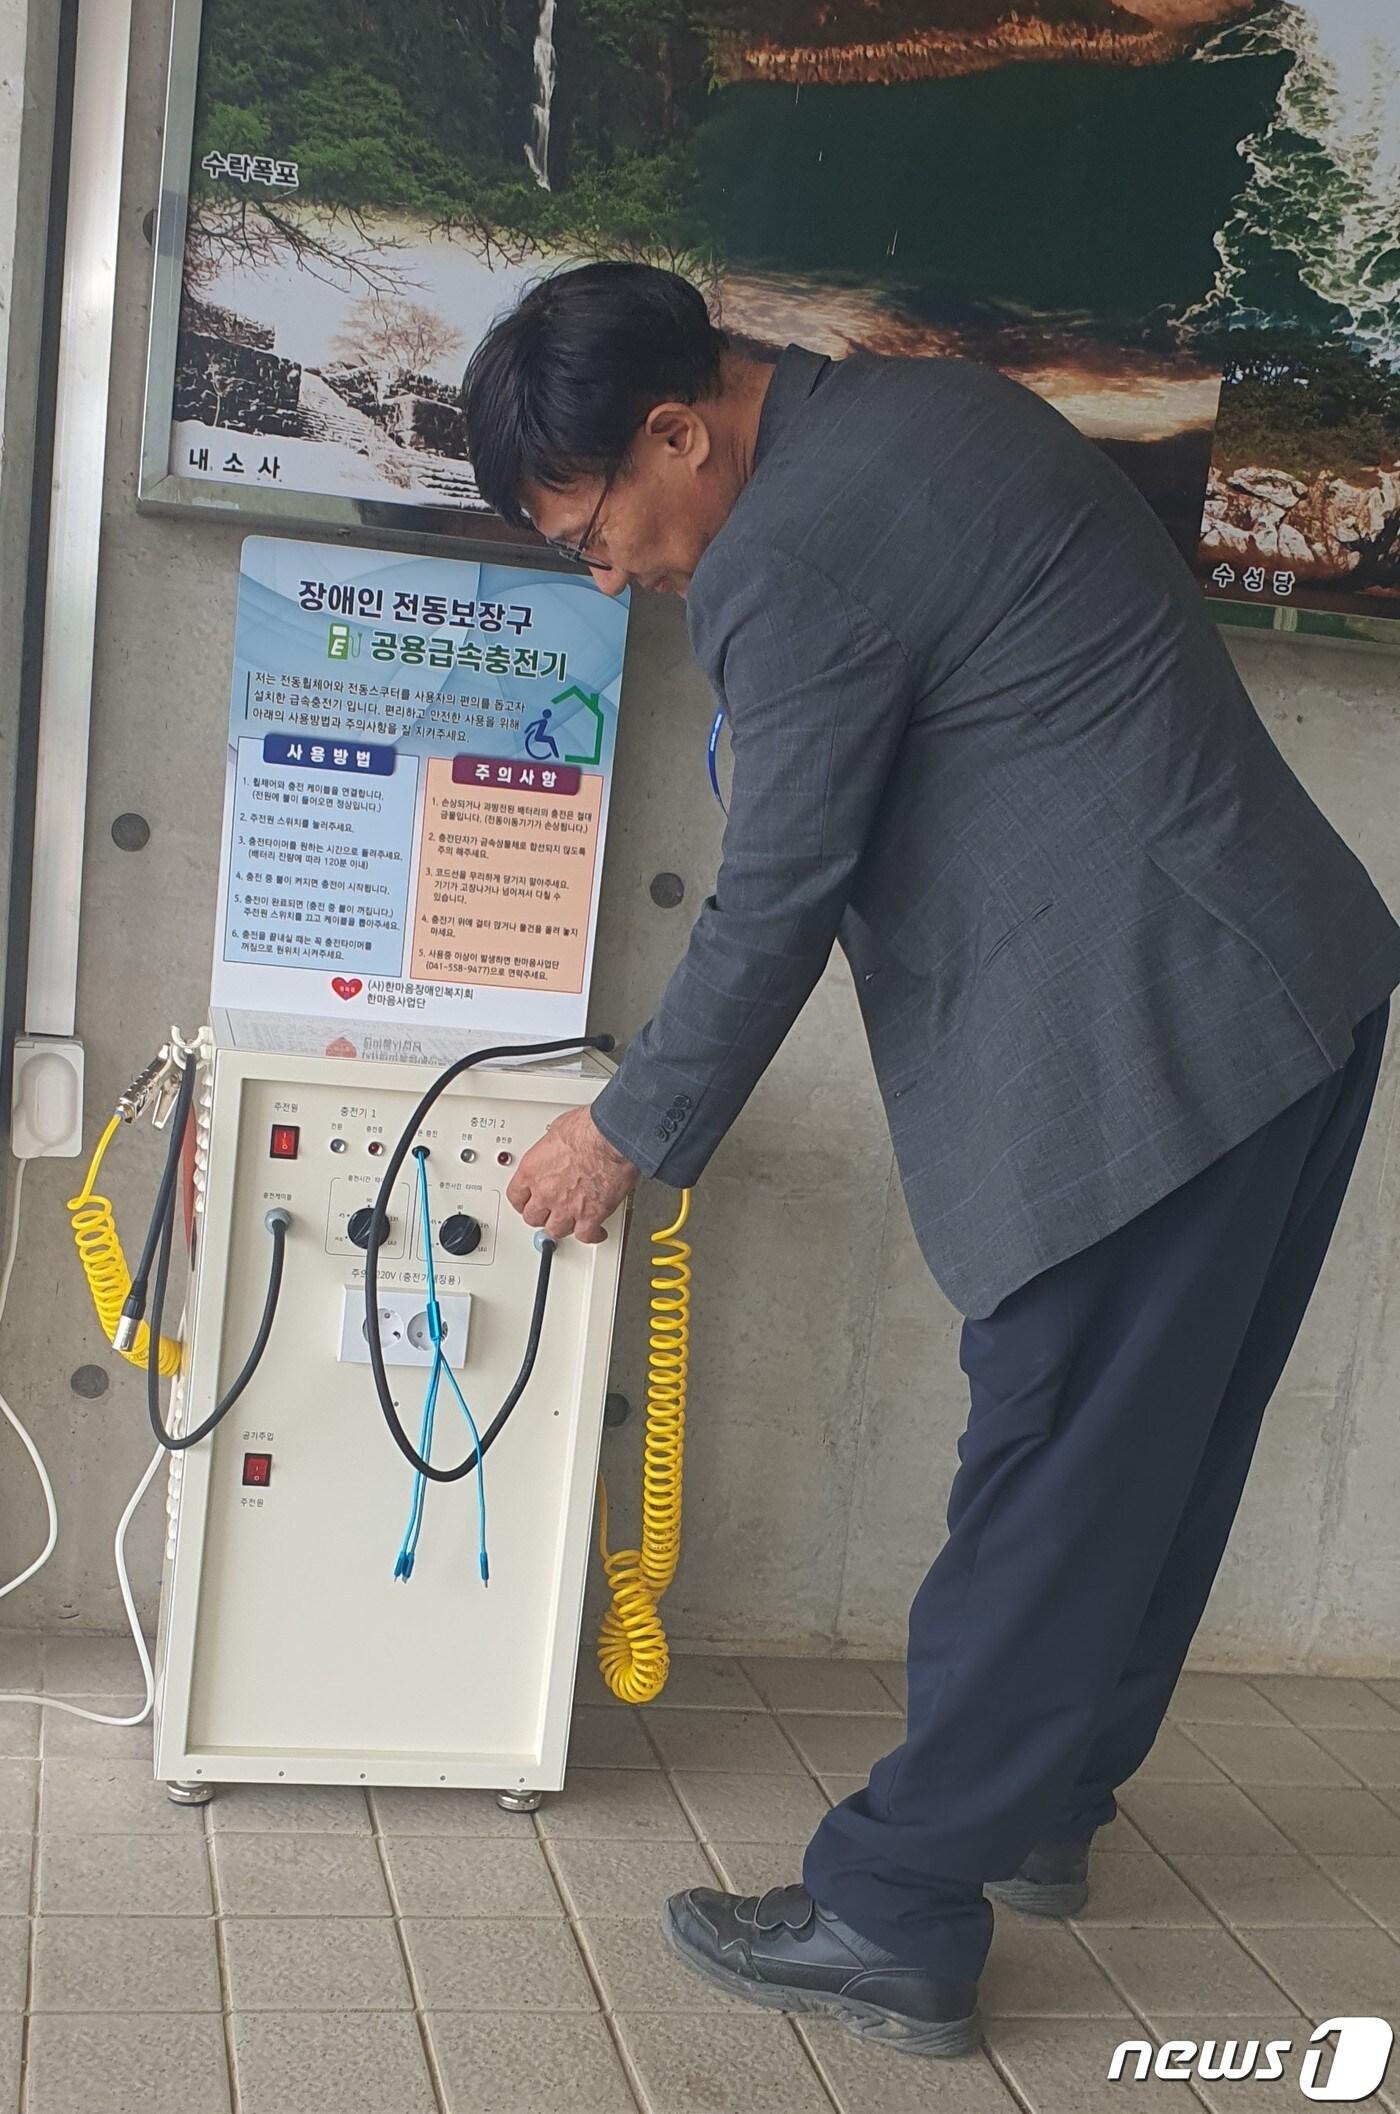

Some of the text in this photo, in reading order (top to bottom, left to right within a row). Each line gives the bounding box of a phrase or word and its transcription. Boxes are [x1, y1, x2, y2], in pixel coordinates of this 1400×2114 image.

[202, 151, 299, 187] 수락폭포
[297, 580, 532, 635] 장애인 전동보장구
[371, 631, 566, 683] 공용급속충전기
[255, 671, 525, 713] 저는 전동휠체어와 전동스쿠터를 사용자의 편의를 돕고자
[254, 689, 519, 733] 설치한 급속충전기 입니다. 편리하고 안전한 사용을 위해
[252, 707, 469, 743] 아래의 사용방법과 주의사항을 잘 지켜주세요.
[243, 776, 249, 786] 1.
[288, 781, 304, 792] 충전
[306, 783, 339, 796] 케이블을
[239, 812, 247, 822] 2.
[250, 813, 274, 825] 주전원
[277, 816, 309, 828] 스위치를
[551, 808, 574, 820] 충전은
[238, 835, 246, 845] 3.
[248, 836, 297, 850] 충전타이머를
[300, 841, 324, 853] 원하는
[326, 844, 358, 856] 시간으로
[438, 833, 478, 846] 충전단자가
[437, 845, 453, 856] 주의
[305, 854, 321, 865] 따라
[324, 857, 347, 868] 120분
[235, 871, 243, 880] 4.
[246, 871, 262, 882] 충전
[265, 873, 273, 884] 중
[321, 879, 345, 891] 충전이
[434, 880, 458, 891] 기기가
[535, 890, 551, 900] 다칠
[553, 892, 561, 901] 수
[234, 893, 242, 903] 5.
[244, 894, 269, 906] 충전이
[271, 897, 303, 909] 완료되면
[306, 900, 325, 912] (충전
[327, 902, 335, 913] 중
[243, 907, 268, 918] 주전원
[270, 910, 302, 921] 스위치를
[305, 913, 321, 923] 끄고
[324, 915, 355, 927] 케이블을
[431, 914, 455, 925] 충전기
[231, 928, 239, 938] 6.
[242, 929, 266, 941] 충전을
[295, 935, 311, 945] 때는
[276, 945, 300, 956] 원위치
[428, 949, 452, 960] 사용중
[454, 951, 478, 962] 이상이
[513, 956, 559, 970] 한마음사업단
[367, 979, 474, 1000] (사)한마음장애인복지회
[367, 992, 426, 1009] 한마음사업단
[340, 1106, 368, 1119] 충전기
[470, 1116, 506, 1129] 충전기 2
